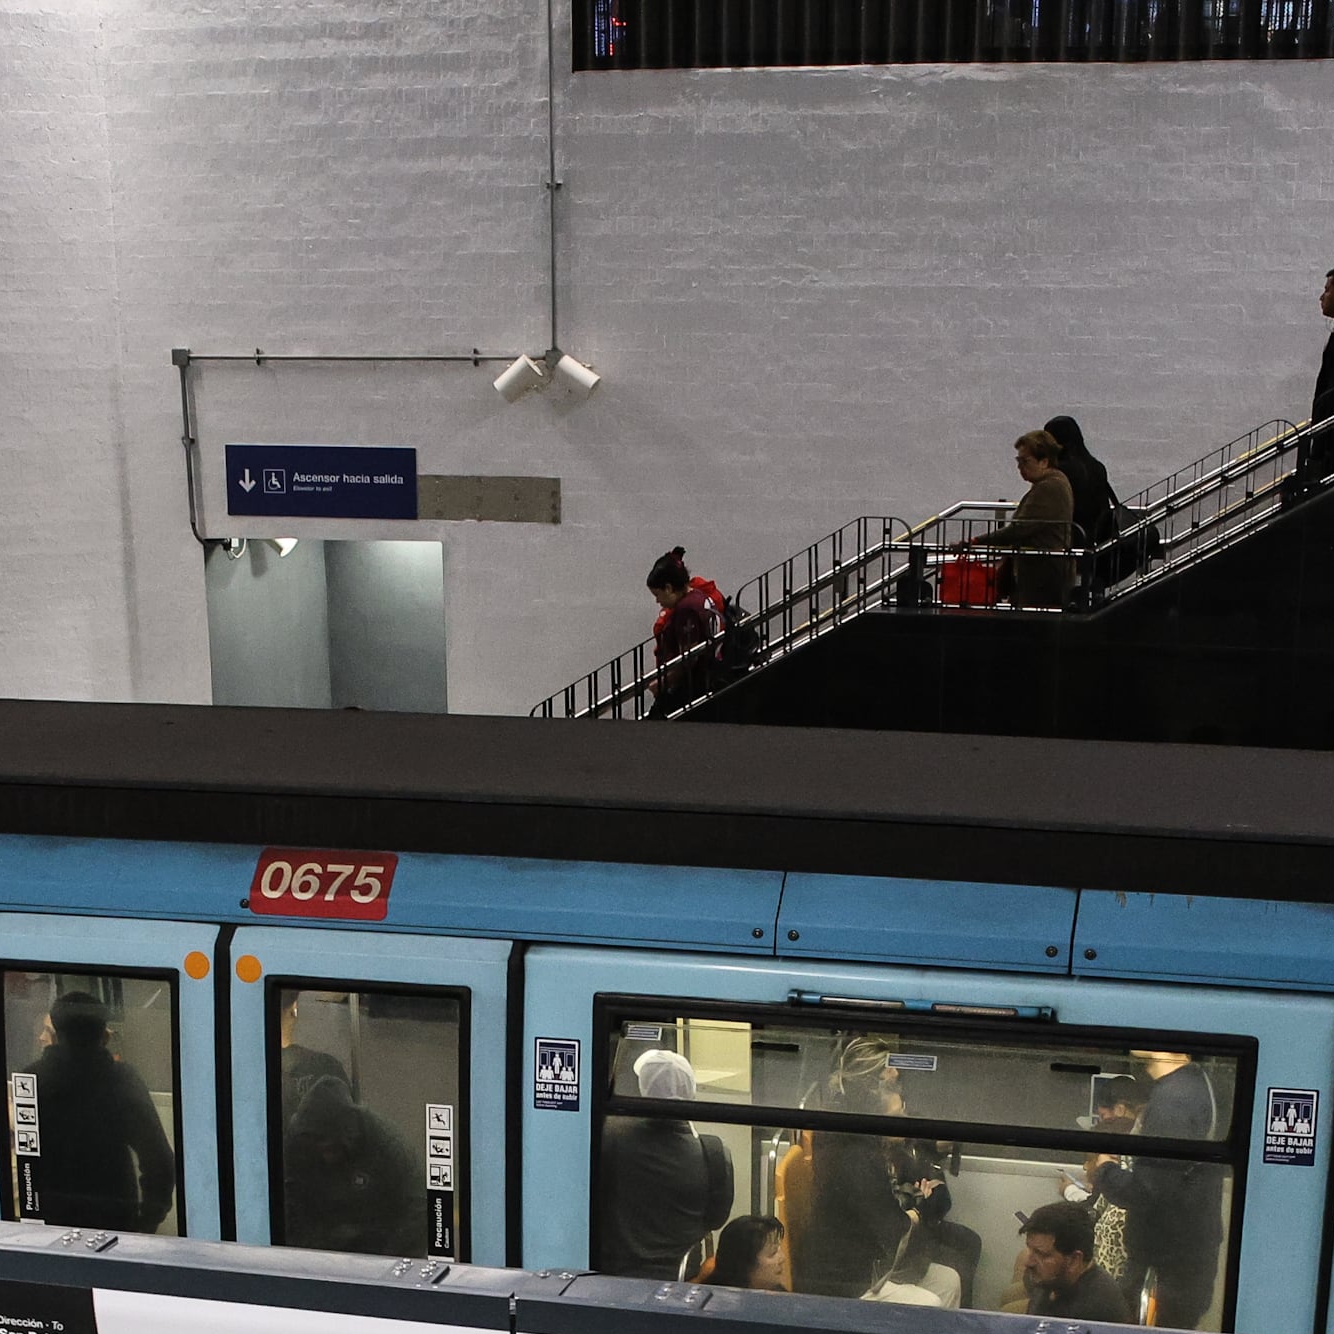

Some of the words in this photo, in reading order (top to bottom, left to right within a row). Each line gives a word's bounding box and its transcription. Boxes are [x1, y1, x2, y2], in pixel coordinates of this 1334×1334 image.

[293, 472, 340, 483] Ascensor
[343, 474, 370, 484] hacia
[373, 475, 404, 484] salida
[261, 860, 385, 904] 0675
[536, 1082, 553, 1091] DEJE
[554, 1084, 578, 1093] BAJAR
[536, 1091, 552, 1099] antes
[1266, 1136, 1286, 1145] DEJE
[1287, 1137, 1314, 1147] BAJAR
[1266, 1145, 1285, 1153] antes
[1295, 1147, 1312, 1155] subir
[24, 1162, 34, 1211] Precaución
[434, 1197, 443, 1248] Precaución
[51, 1320, 64, 1331] To
